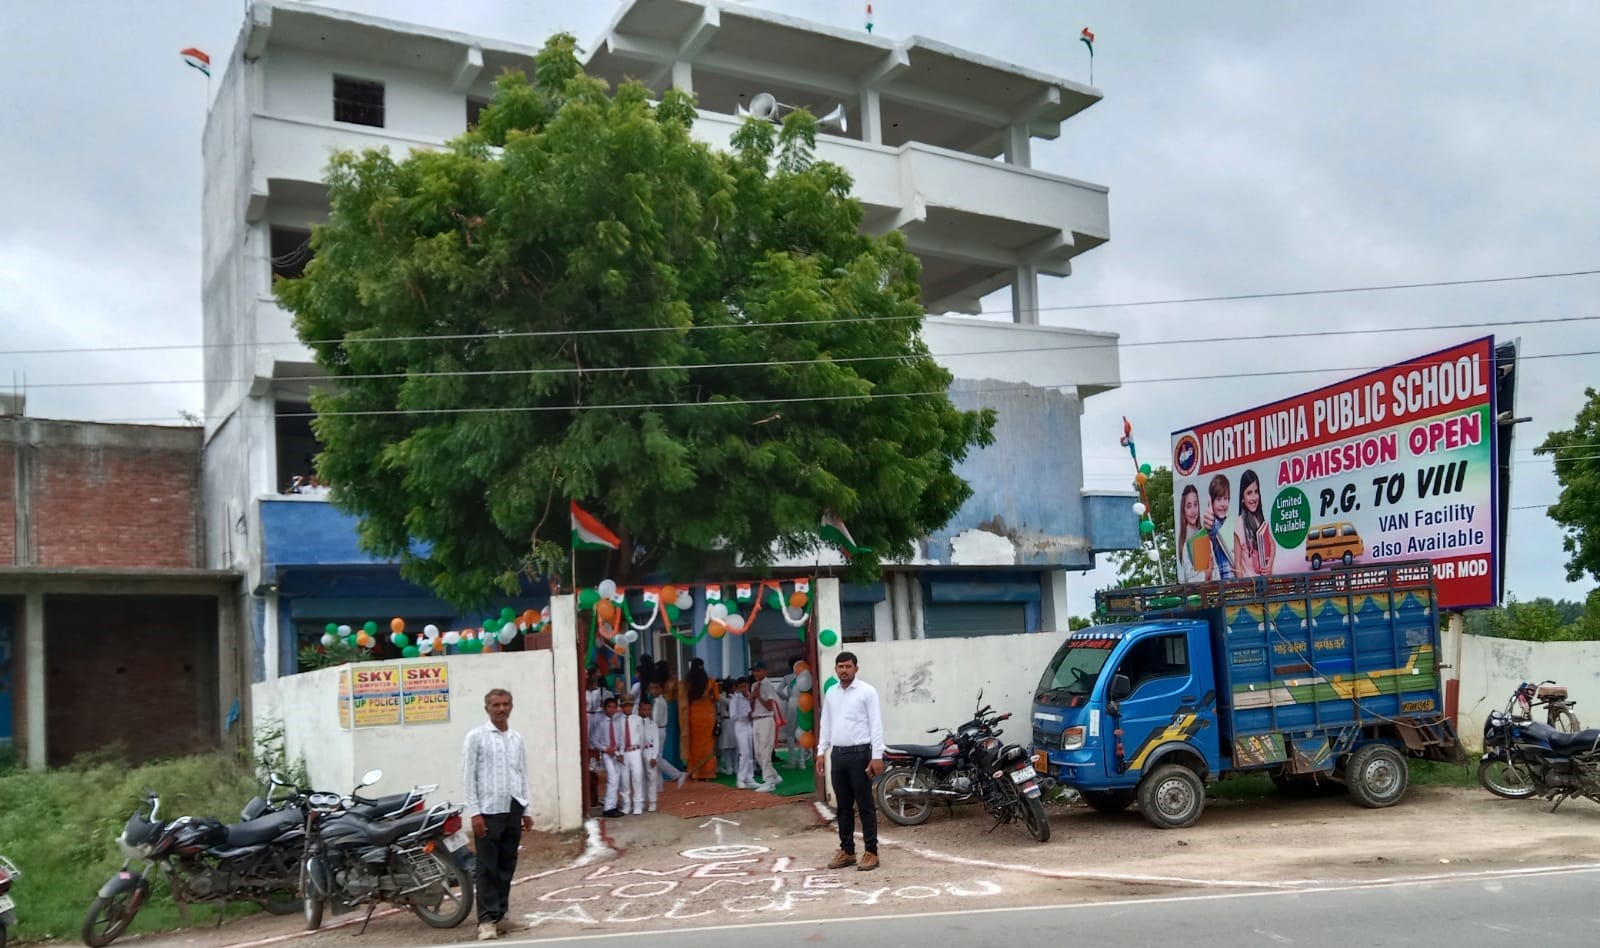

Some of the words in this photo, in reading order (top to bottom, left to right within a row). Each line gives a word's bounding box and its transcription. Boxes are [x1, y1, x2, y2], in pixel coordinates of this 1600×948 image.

[1202, 420, 1256, 467] NORTH
[1260, 405, 1309, 452] INDIA
[1313, 381, 1386, 438] PUBLIC
[1392, 353, 1487, 416] SCHOOL
[1277, 433, 1397, 485] ADMISSION
[1409, 413, 1480, 455] OPEN
[1319, 483, 1361, 517] P.G.
[1372, 472, 1405, 507] TO
[1417, 460, 1468, 499] VIII
[1276, 492, 1302, 509] Limited
[1280, 508, 1299, 521] Seats
[1378, 512, 1409, 533] VAN
[1415, 504, 1475, 528] Facility
[1274, 518, 1306, 534] Available
[1372, 541, 1401, 558] also
[1407, 528, 1484, 553] Available
[1458, 558, 1489, 579] MOD
[357, 671, 393, 683] SKY
[406, 668, 442, 680] SKY
[354, 699, 367, 708] UP
[368, 697, 399, 707] POLICE
[404, 696, 416, 705] UP
[417, 694, 449, 704] POLICE
[585, 857, 825, 880] WEL
[537, 873, 845, 901] COME
[523, 898, 717, 927] ALL
[844, 879, 1002, 905] YOU
